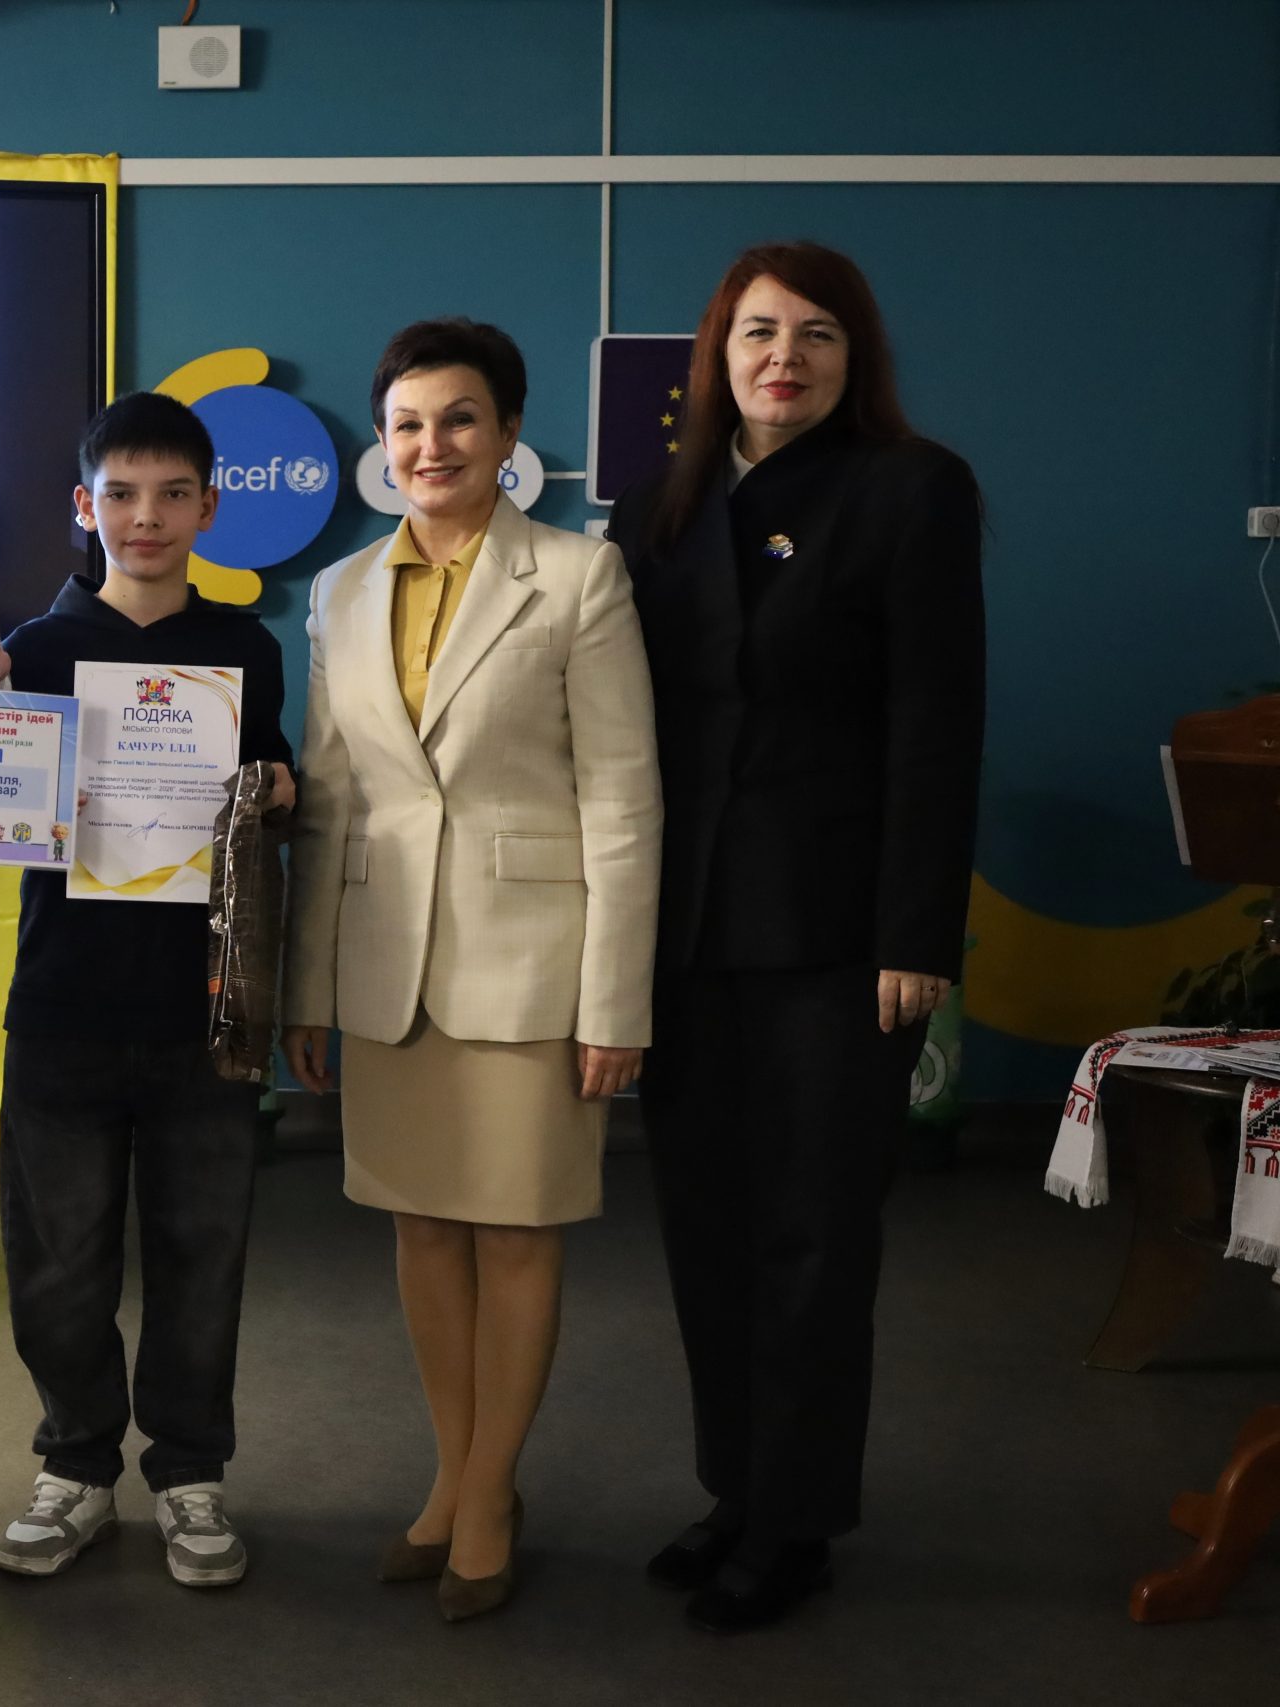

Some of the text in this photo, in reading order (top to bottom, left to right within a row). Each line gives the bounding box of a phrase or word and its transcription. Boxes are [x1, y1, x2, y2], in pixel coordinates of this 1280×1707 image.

[210, 456, 282, 491] icef
[27, 713, 54, 724] ідей
[123, 708, 192, 724] ПОДЯКА
[122, 725, 192, 734] МІСЬКОГО ГОЛОВИ
[15, 739, 33, 747] ради
[118, 741, 196, 753] КАЧУРУ ІЛЛІ
